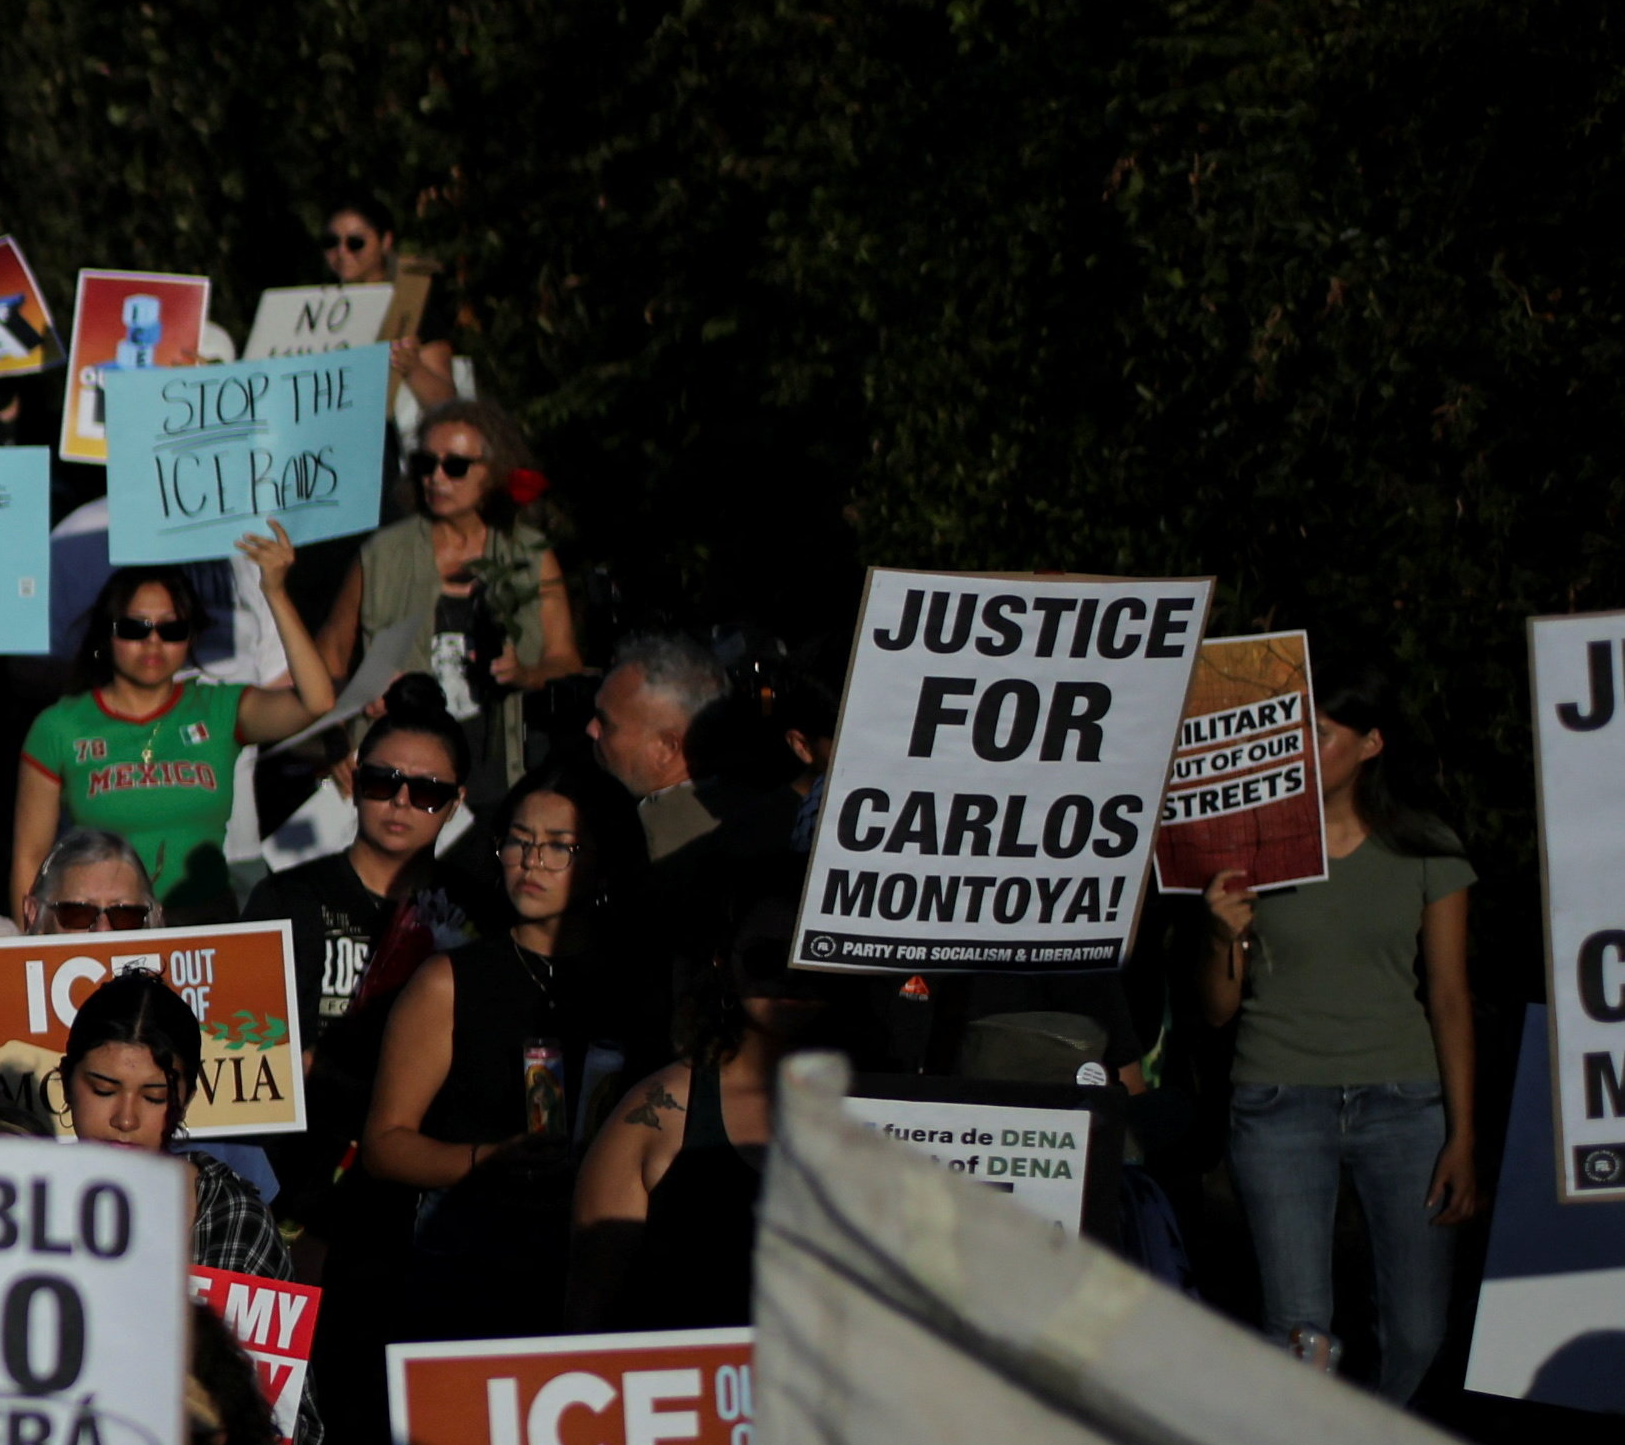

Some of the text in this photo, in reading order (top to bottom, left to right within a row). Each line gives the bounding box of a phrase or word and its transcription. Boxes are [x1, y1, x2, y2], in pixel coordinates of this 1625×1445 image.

[295, 296, 351, 335] NO
[162, 367, 353, 435] STOP THE
[251, 448, 337, 515] RAIDS
[873, 588, 1195, 659] JUSTICE
[908, 676, 1113, 763] FOR
[1210, 749, 1243, 771] OF
[1248, 733, 1298, 761] OUR
[88, 761, 216, 798] MEXICO
[1162, 767, 1302, 821] STREETS
[837, 787, 1143, 859] CARLOS
[821, 869, 1125, 923] MONTOYA!
[842, 941, 1113, 963] PARTY FOR SOCIALISM & LIBERATION
[960, 1129, 993, 1145] de
[1001, 1130, 1075, 1150] DENA
[987, 1157, 1072, 1179] DENA
